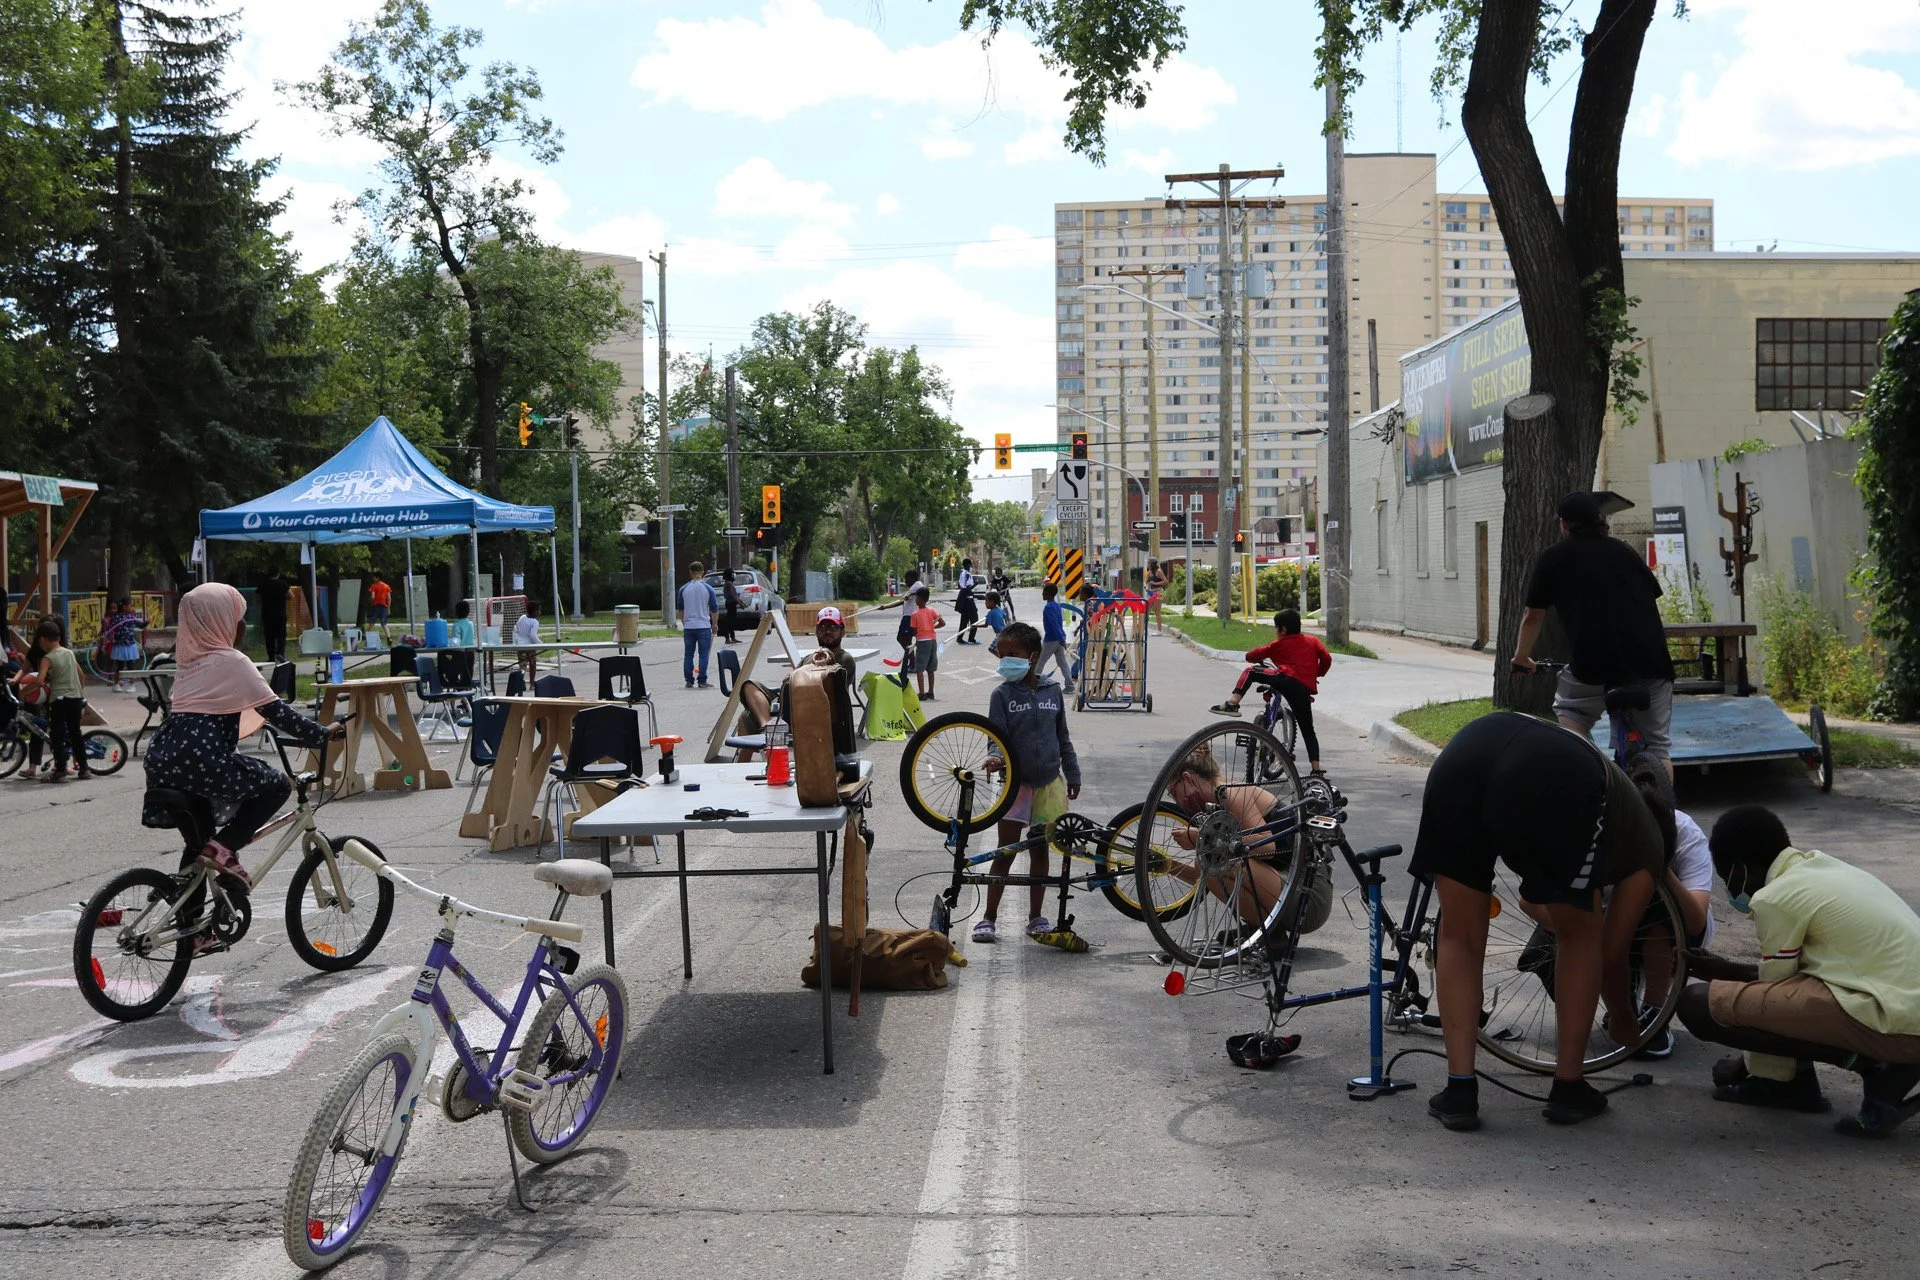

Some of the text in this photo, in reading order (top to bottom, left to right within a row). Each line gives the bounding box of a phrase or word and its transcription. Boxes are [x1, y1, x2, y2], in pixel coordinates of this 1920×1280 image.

[1462, 331, 1492, 373] FULL
[1471, 367, 1499, 409] SIGN
[1468, 412, 1504, 443] www.Cont
[292, 475, 413, 503] ACTION
[312, 469, 377, 484] green
[316, 493, 392, 505] centre
[268, 509, 429, 528] Your Green Living Hub
